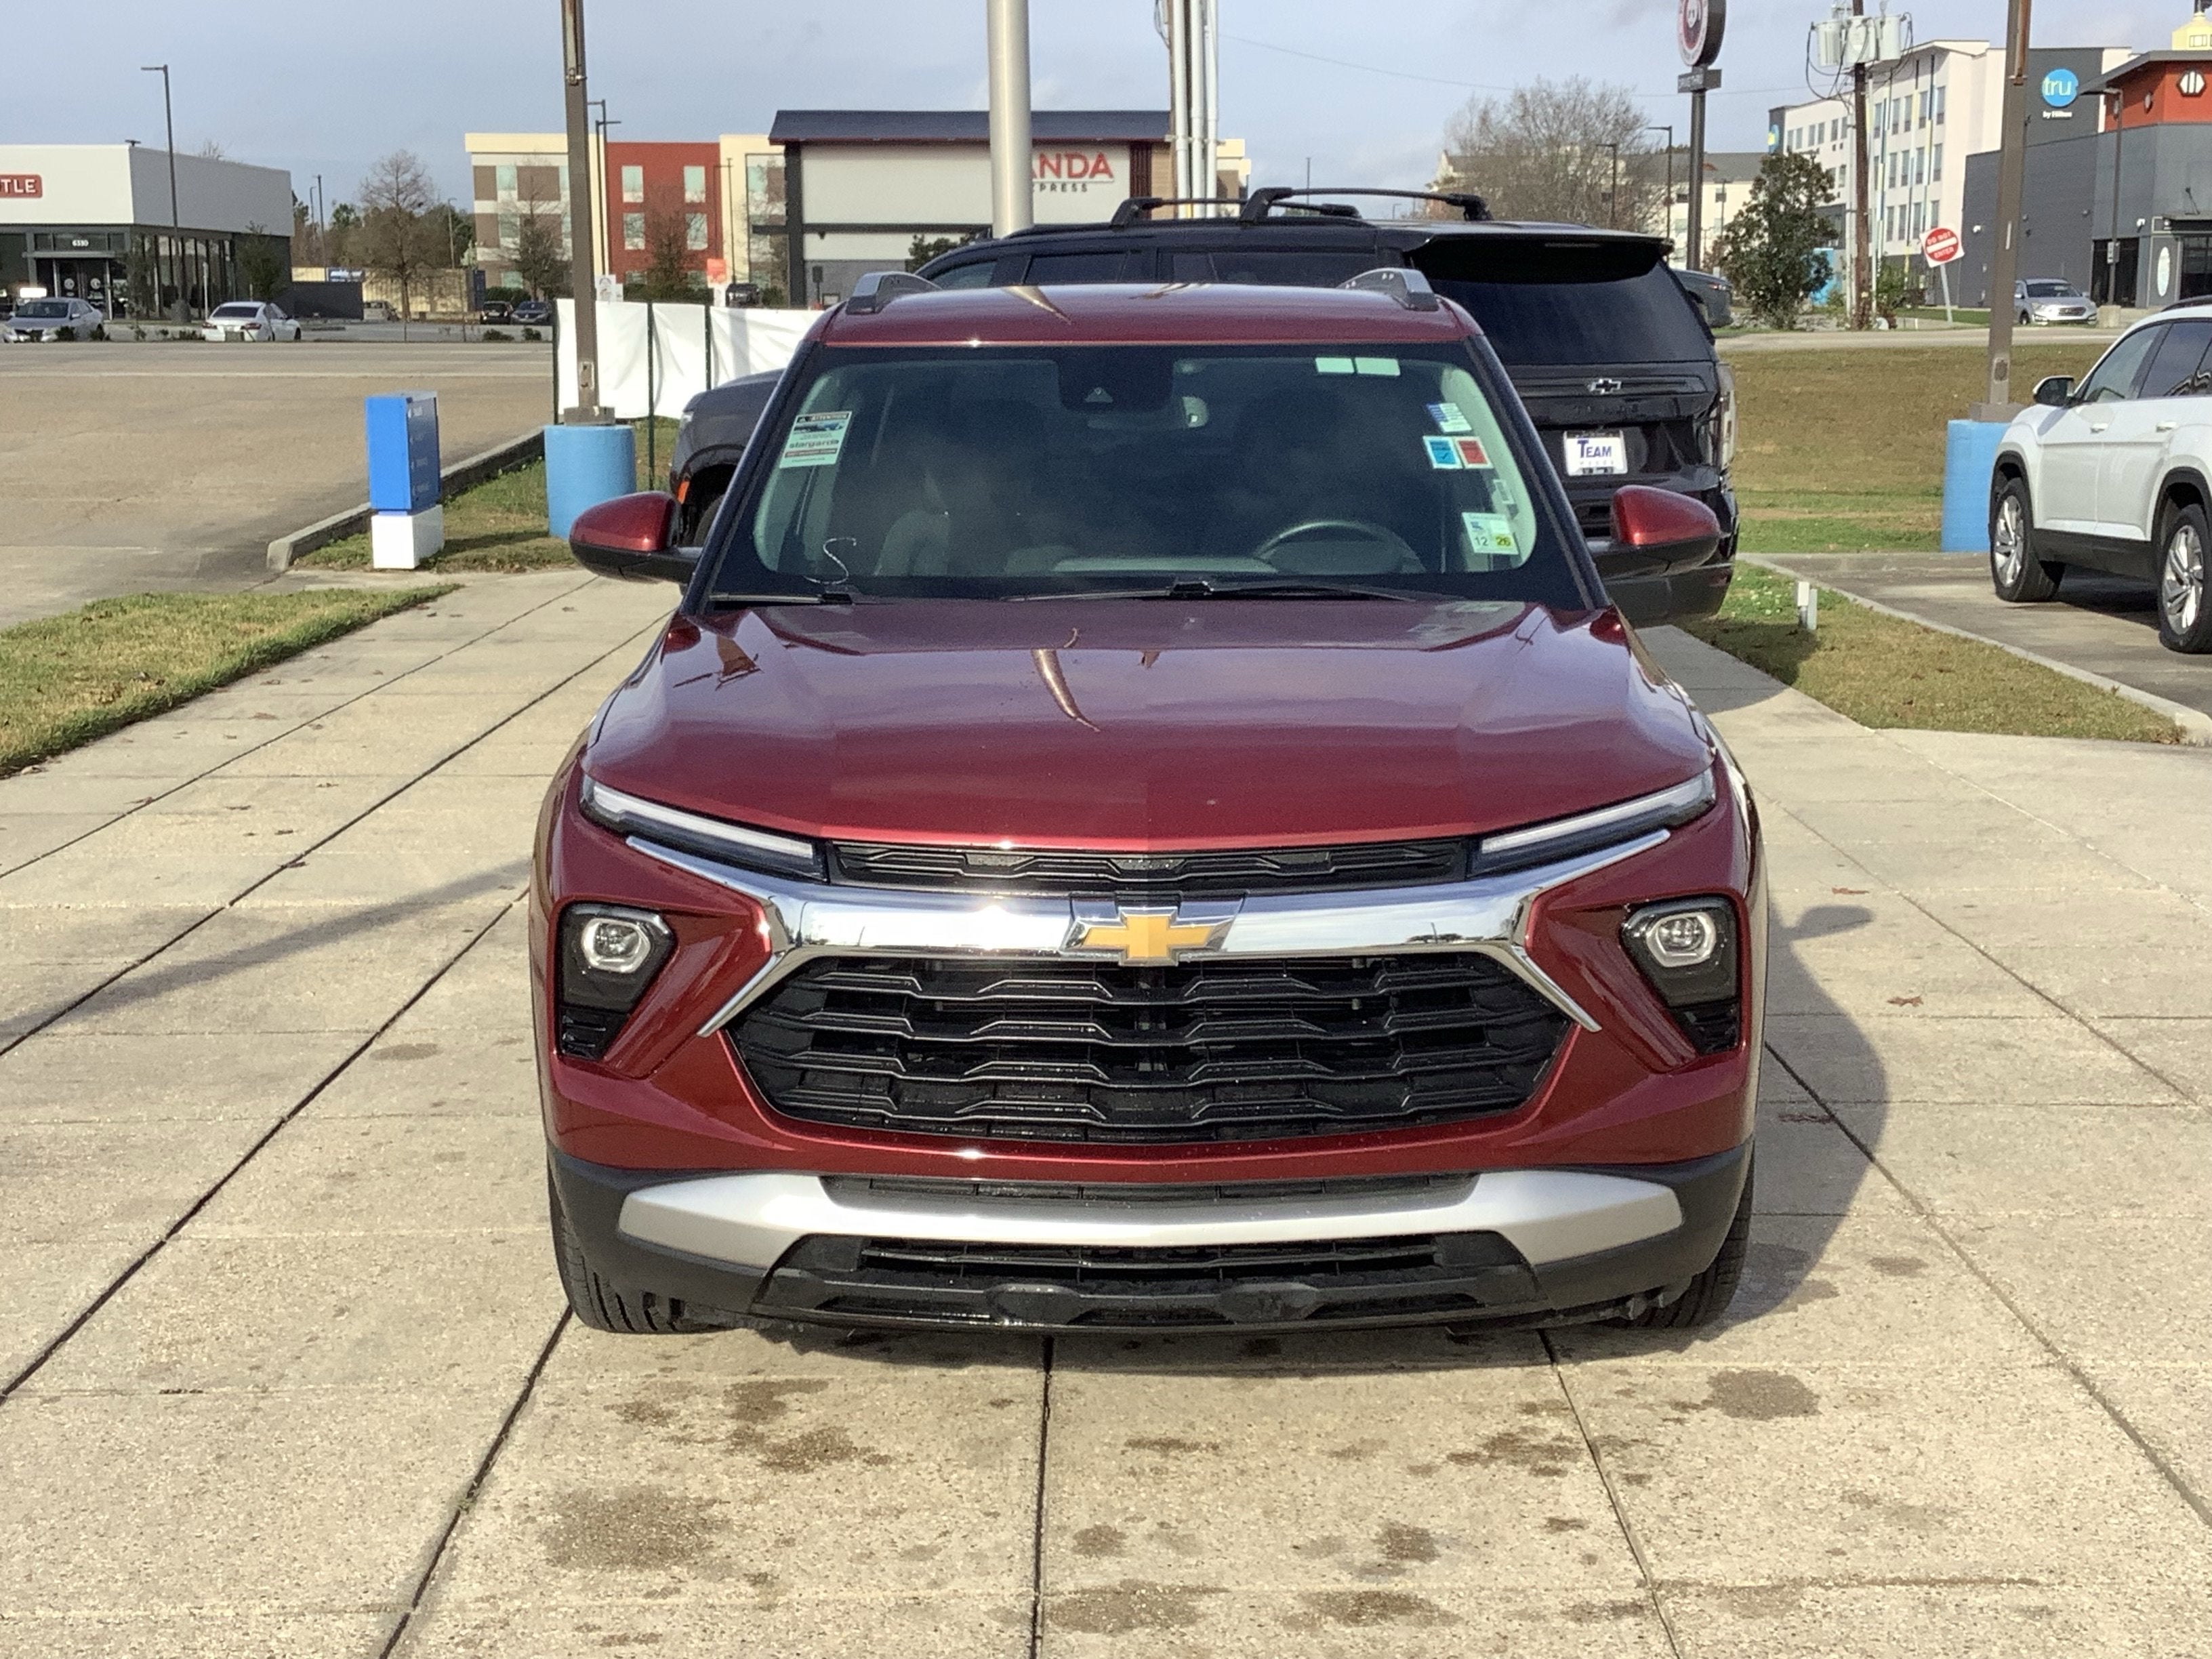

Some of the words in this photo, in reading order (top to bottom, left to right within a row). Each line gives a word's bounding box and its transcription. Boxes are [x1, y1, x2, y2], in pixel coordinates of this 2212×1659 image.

[2043, 76, 2072, 96] tru
[1031, 152, 1114, 179] NDA
[1033, 183, 1088, 192] PRESS
[1927, 236, 1937, 245] DO
[1938, 231, 1951, 241] NOT
[1933, 246, 1954, 259] ENTER
[1577, 439, 1612, 458] TEAM
[1474, 536, 1489, 547] 12
